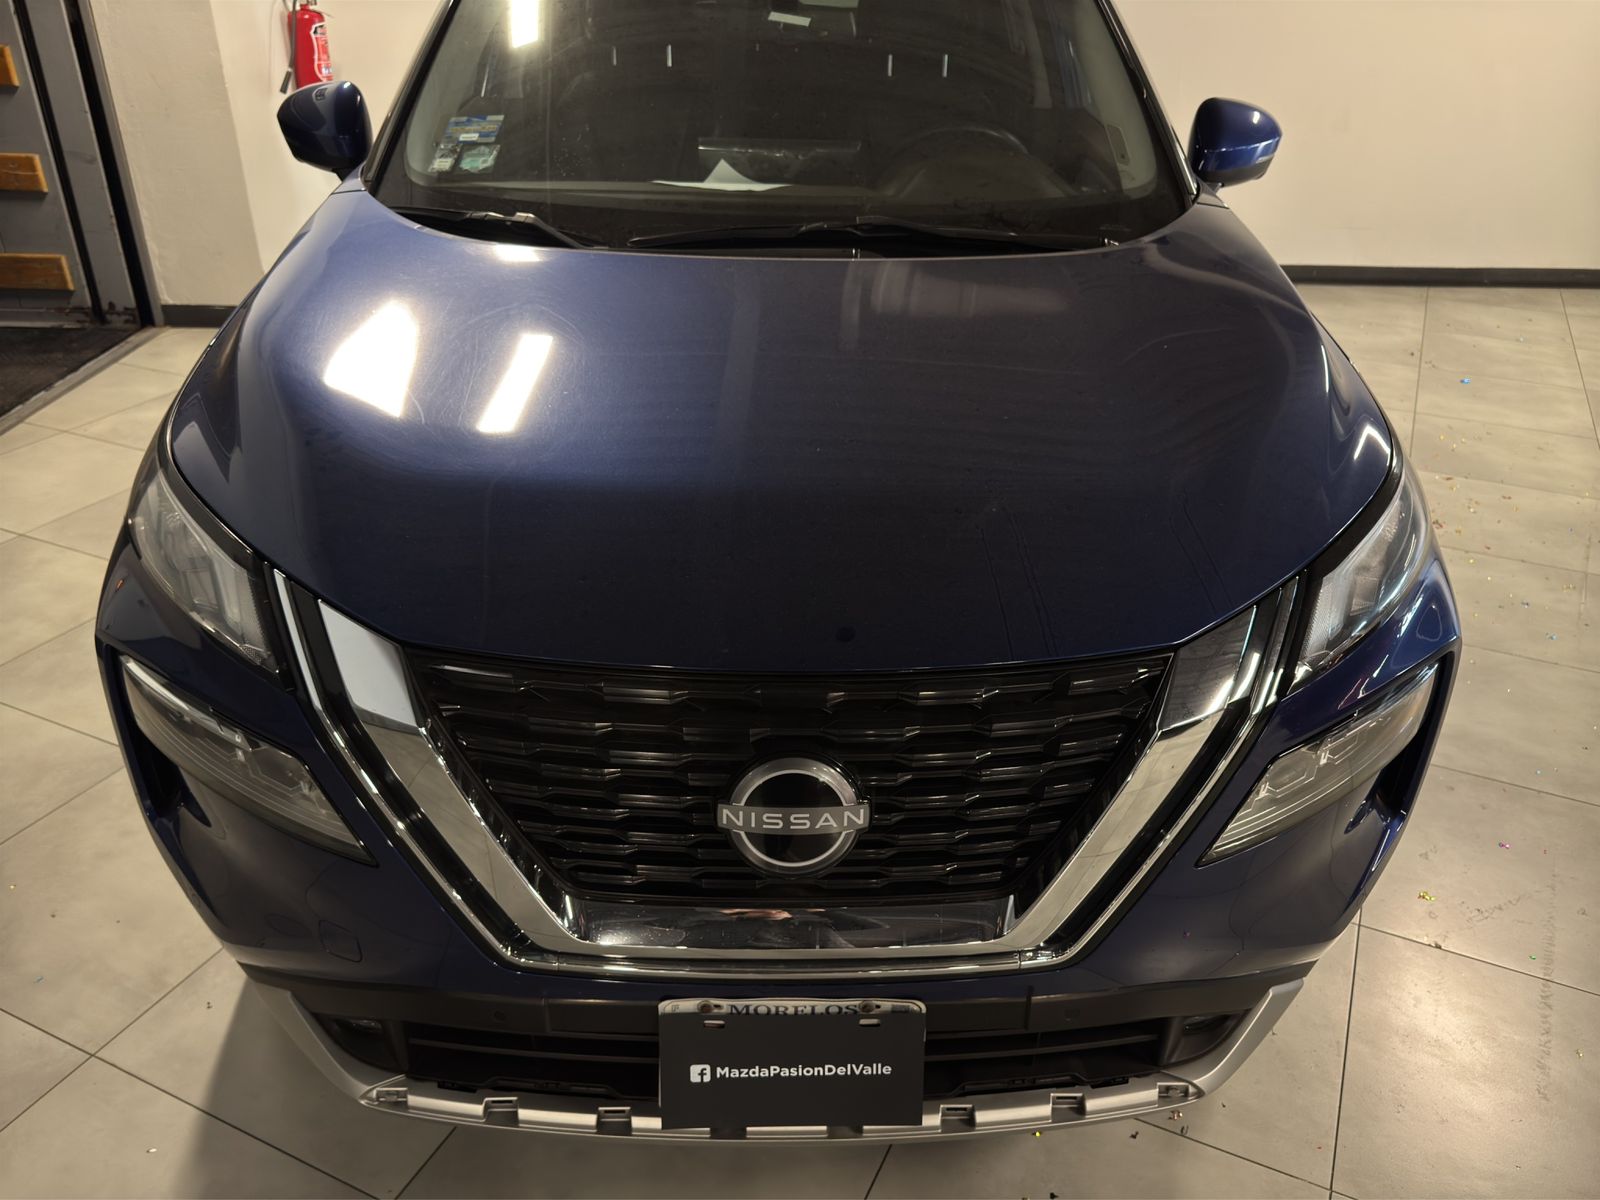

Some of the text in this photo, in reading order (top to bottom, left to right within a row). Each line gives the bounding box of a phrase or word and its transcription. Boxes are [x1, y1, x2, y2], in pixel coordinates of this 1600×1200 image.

[722, 808, 865, 829] NISSAN
[729, 1004, 859, 1016] MORELOS
[716, 1063, 892, 1079] MazdaPasionDelValle
